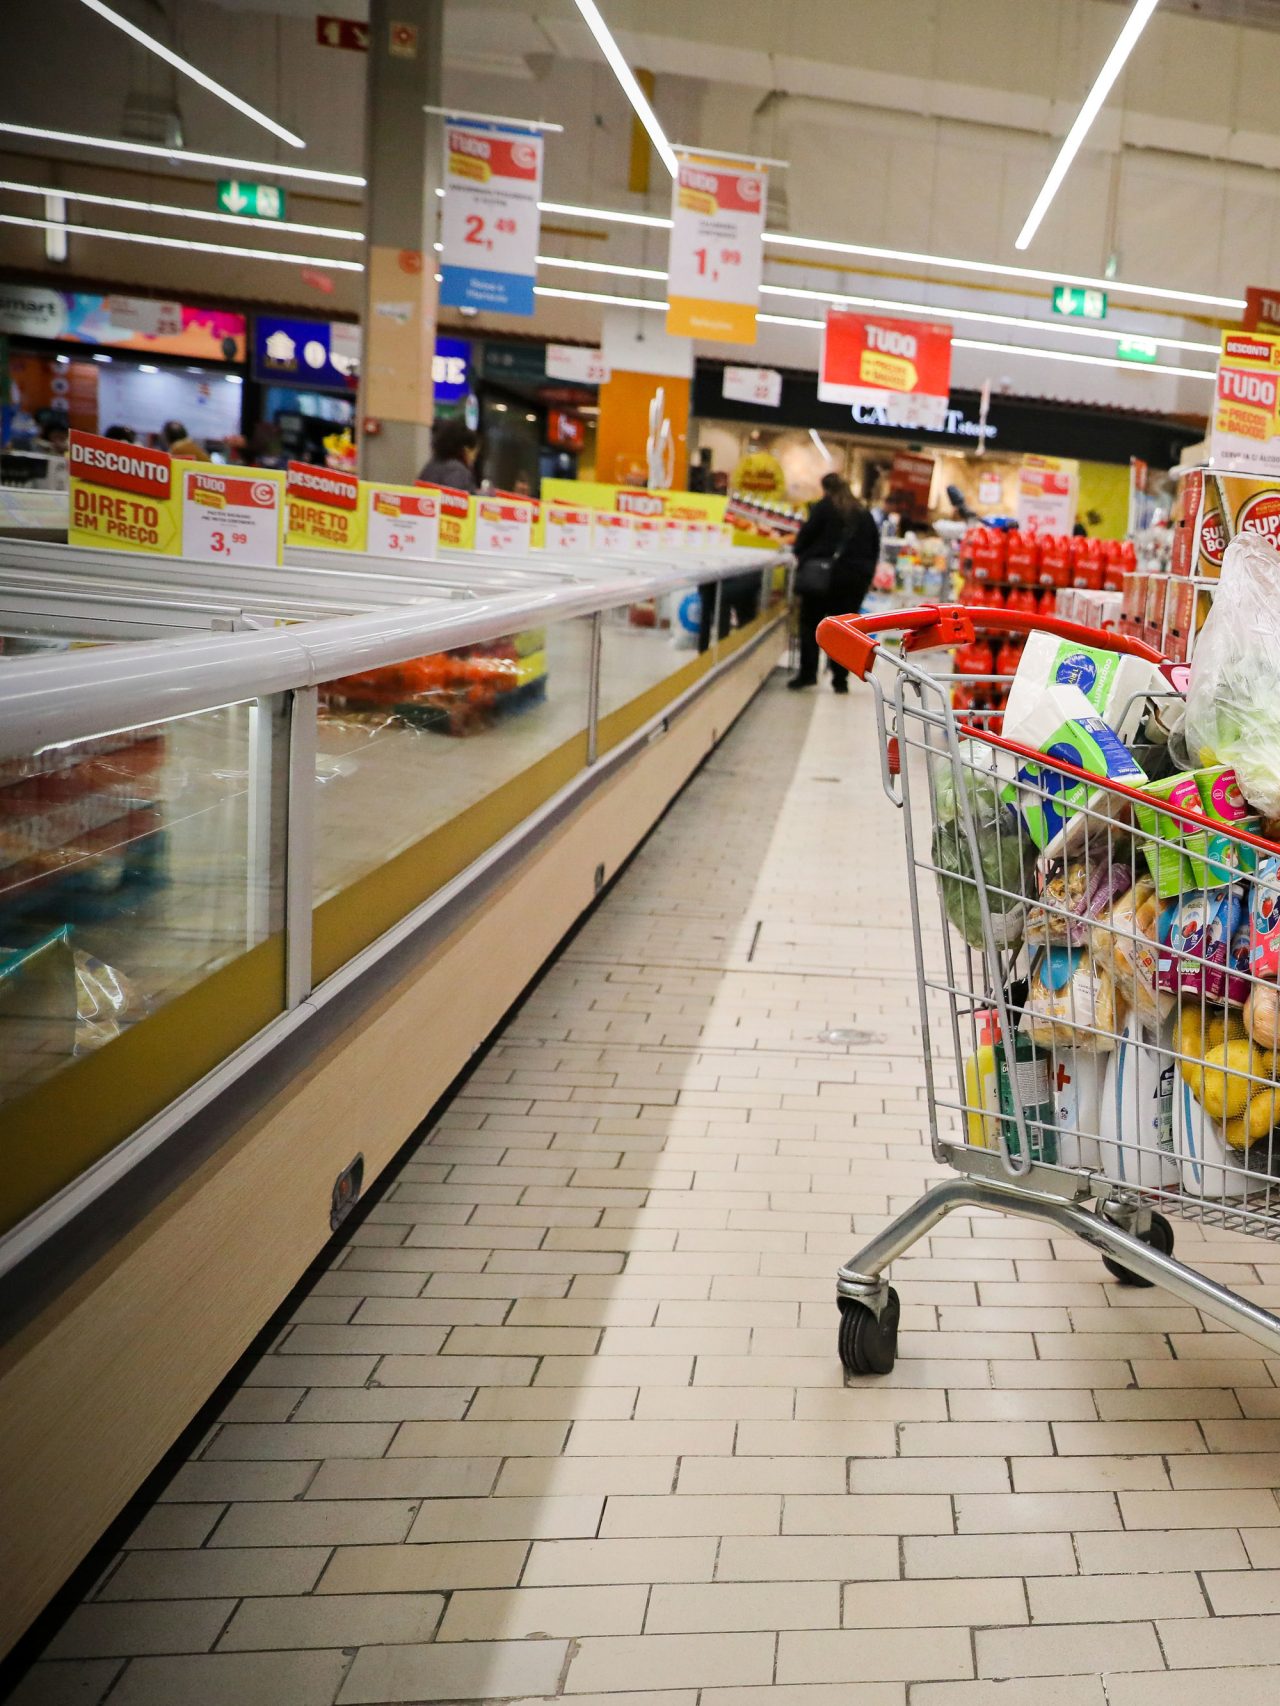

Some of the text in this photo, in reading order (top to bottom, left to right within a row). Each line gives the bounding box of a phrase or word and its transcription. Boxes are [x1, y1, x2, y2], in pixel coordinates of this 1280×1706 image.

[865, 324, 917, 358] TUDO
[1220, 371, 1274, 405] TUDO
[71, 443, 169, 483] DESCONTO
[195, 475, 226, 493] TUDO
[288, 470, 357, 498] DESCONTO
[74, 489, 159, 528] DIRETO
[289, 503, 348, 530] DIRETO
[74, 512, 158, 544] EM PREÇO
[210, 531, 248, 556] 3,99
